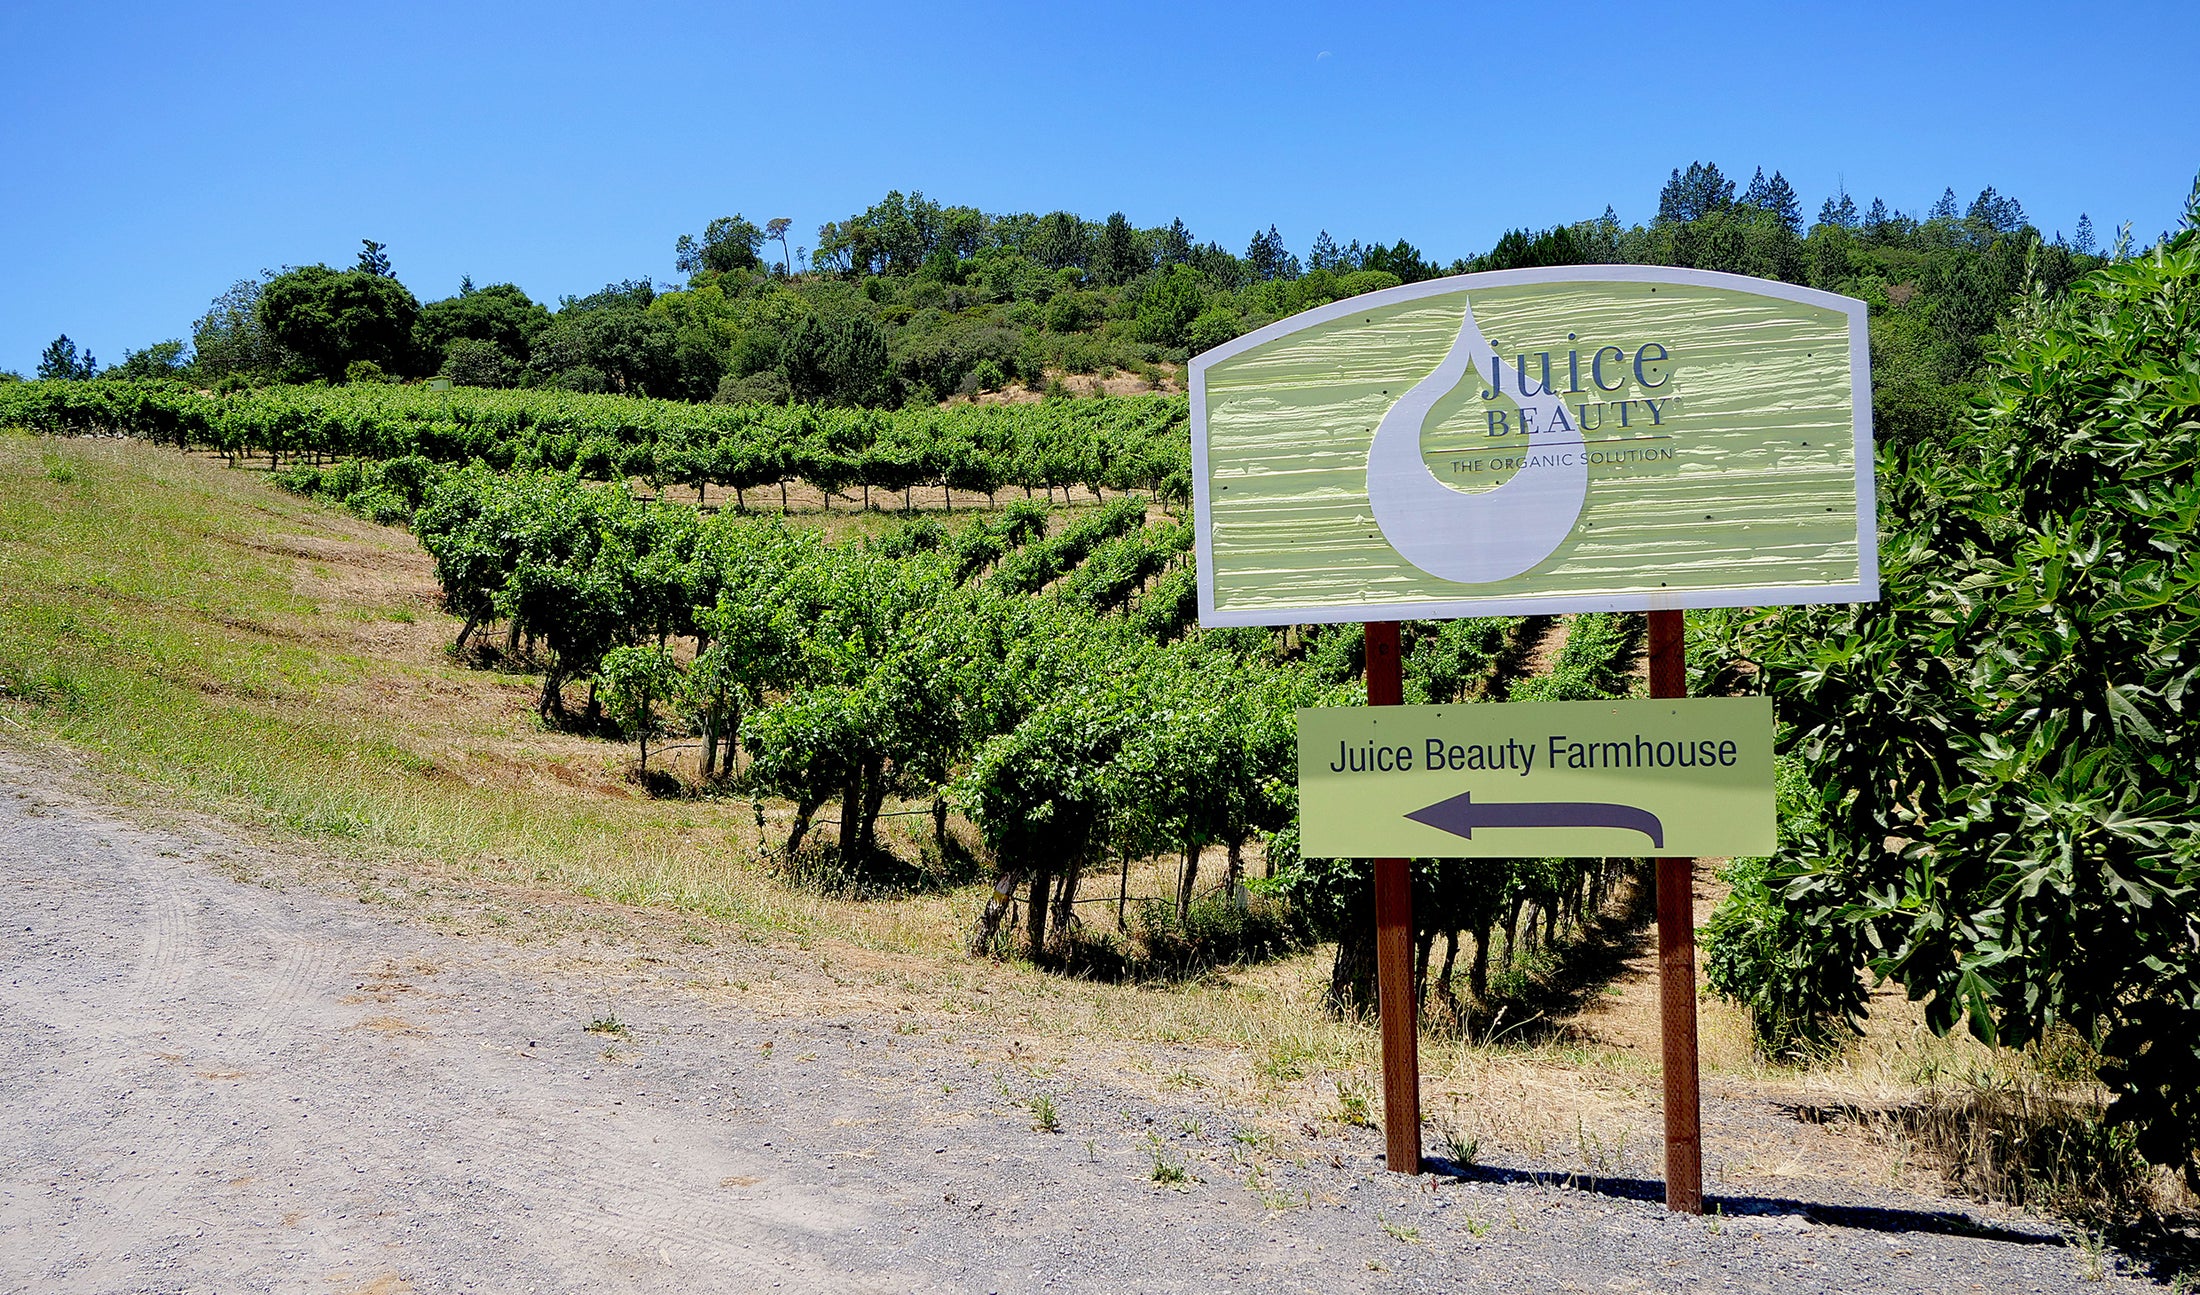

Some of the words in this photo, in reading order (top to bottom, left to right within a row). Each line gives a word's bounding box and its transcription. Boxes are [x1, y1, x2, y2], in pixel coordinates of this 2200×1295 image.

[1481, 333, 1669, 400] juice
[1451, 460, 1483, 473] THE
[1490, 453, 1573, 471] ORGANIC
[1580, 448, 1673, 465] SOLUTION
[1330, 740, 1413, 773] Juice
[1426, 737, 1536, 777] Beauty
[1550, 734, 1737, 769] Farmhouse
